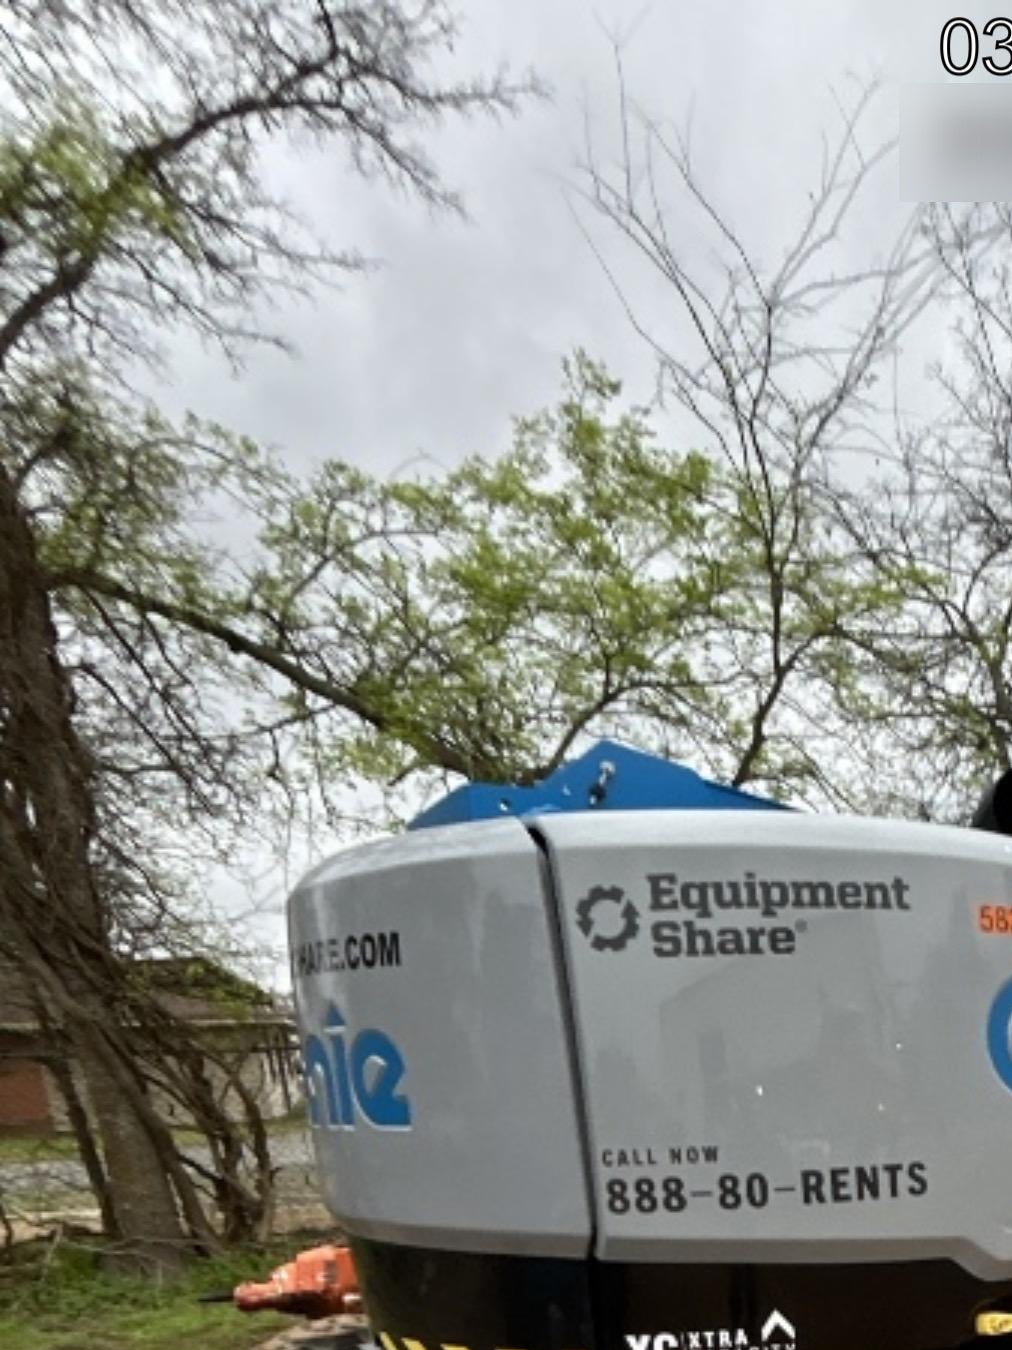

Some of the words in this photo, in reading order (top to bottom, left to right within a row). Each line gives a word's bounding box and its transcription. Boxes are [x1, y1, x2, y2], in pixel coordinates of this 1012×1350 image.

[646, 871, 911, 918] Equipment
[601, 1148, 657, 1168] CALL
[669, 1146, 719, 1165] NOW
[606, 1161, 928, 1215] 888-80-RENTS
[687, 1328, 748, 1349] XTRA
